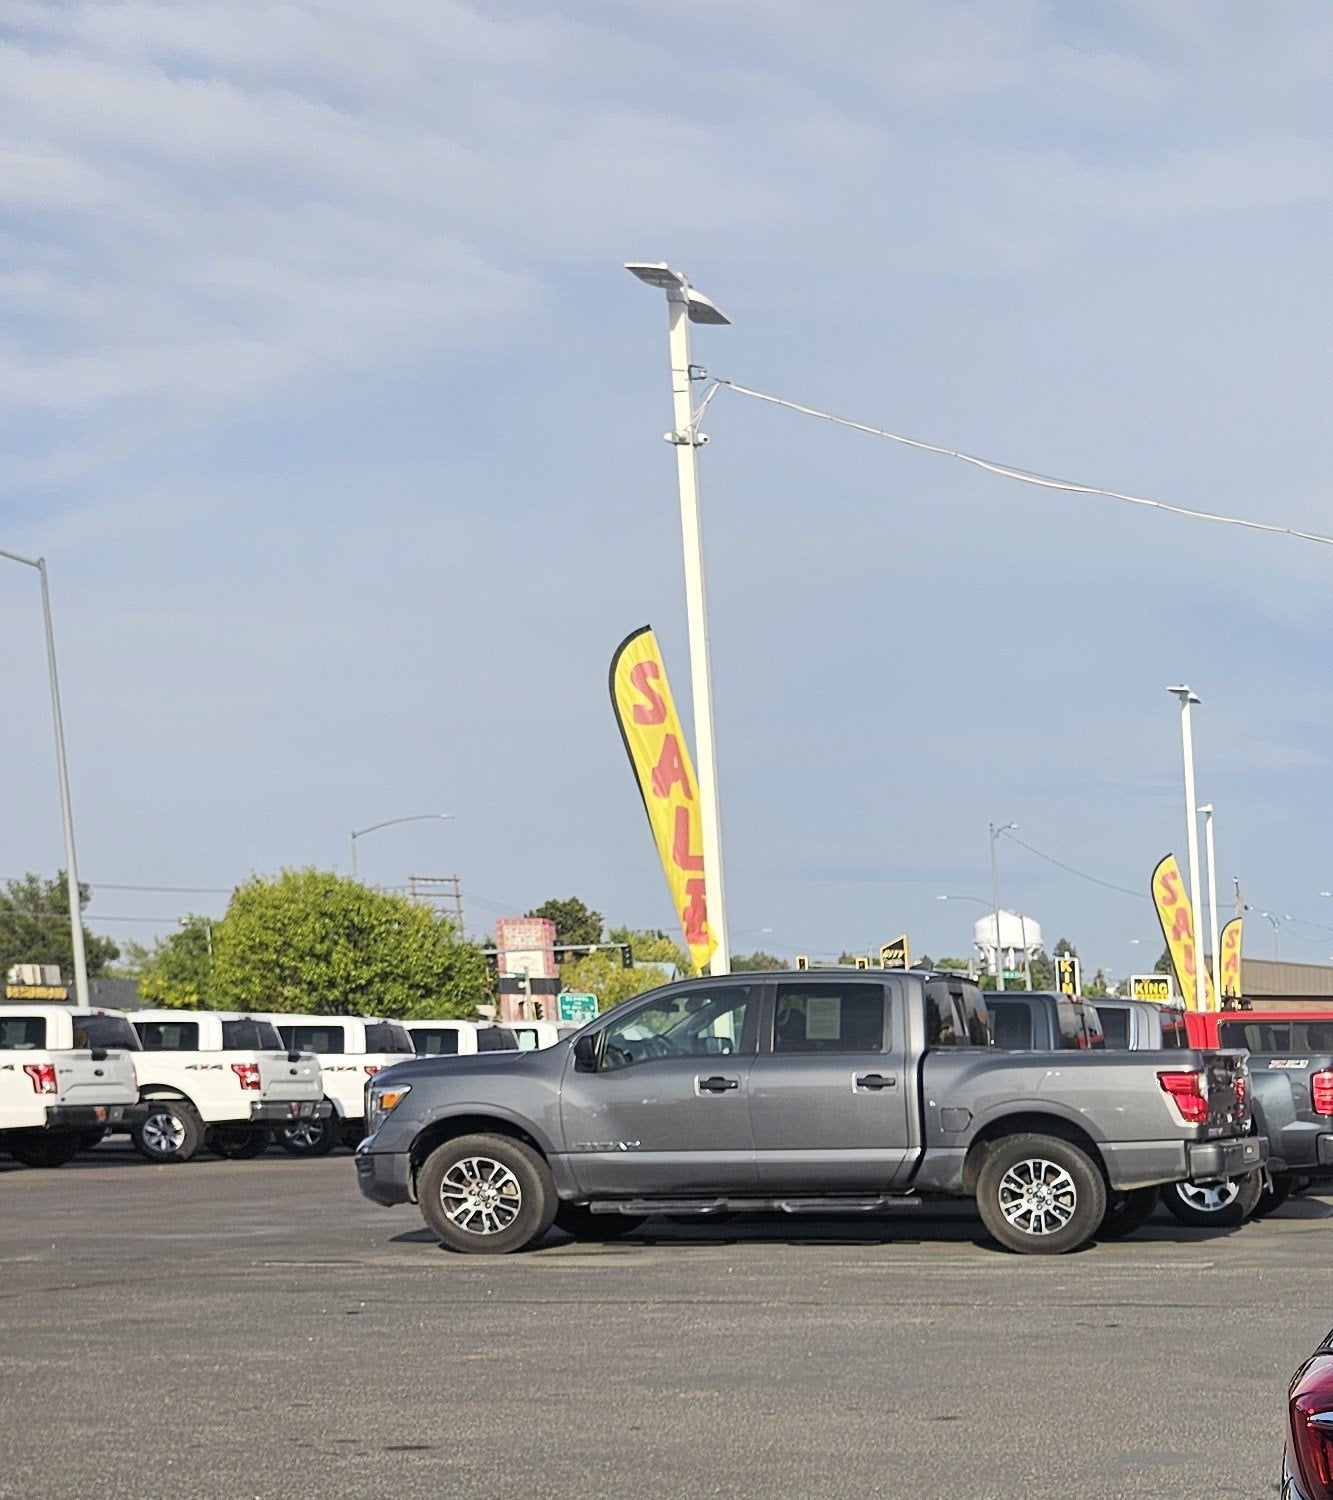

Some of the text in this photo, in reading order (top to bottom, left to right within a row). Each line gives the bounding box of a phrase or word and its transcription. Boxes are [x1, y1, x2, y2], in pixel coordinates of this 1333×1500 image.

[630, 660, 710, 945] SALE
[1060, 959, 1073, 995] KIN
[1135, 982, 1168, 995] KING
